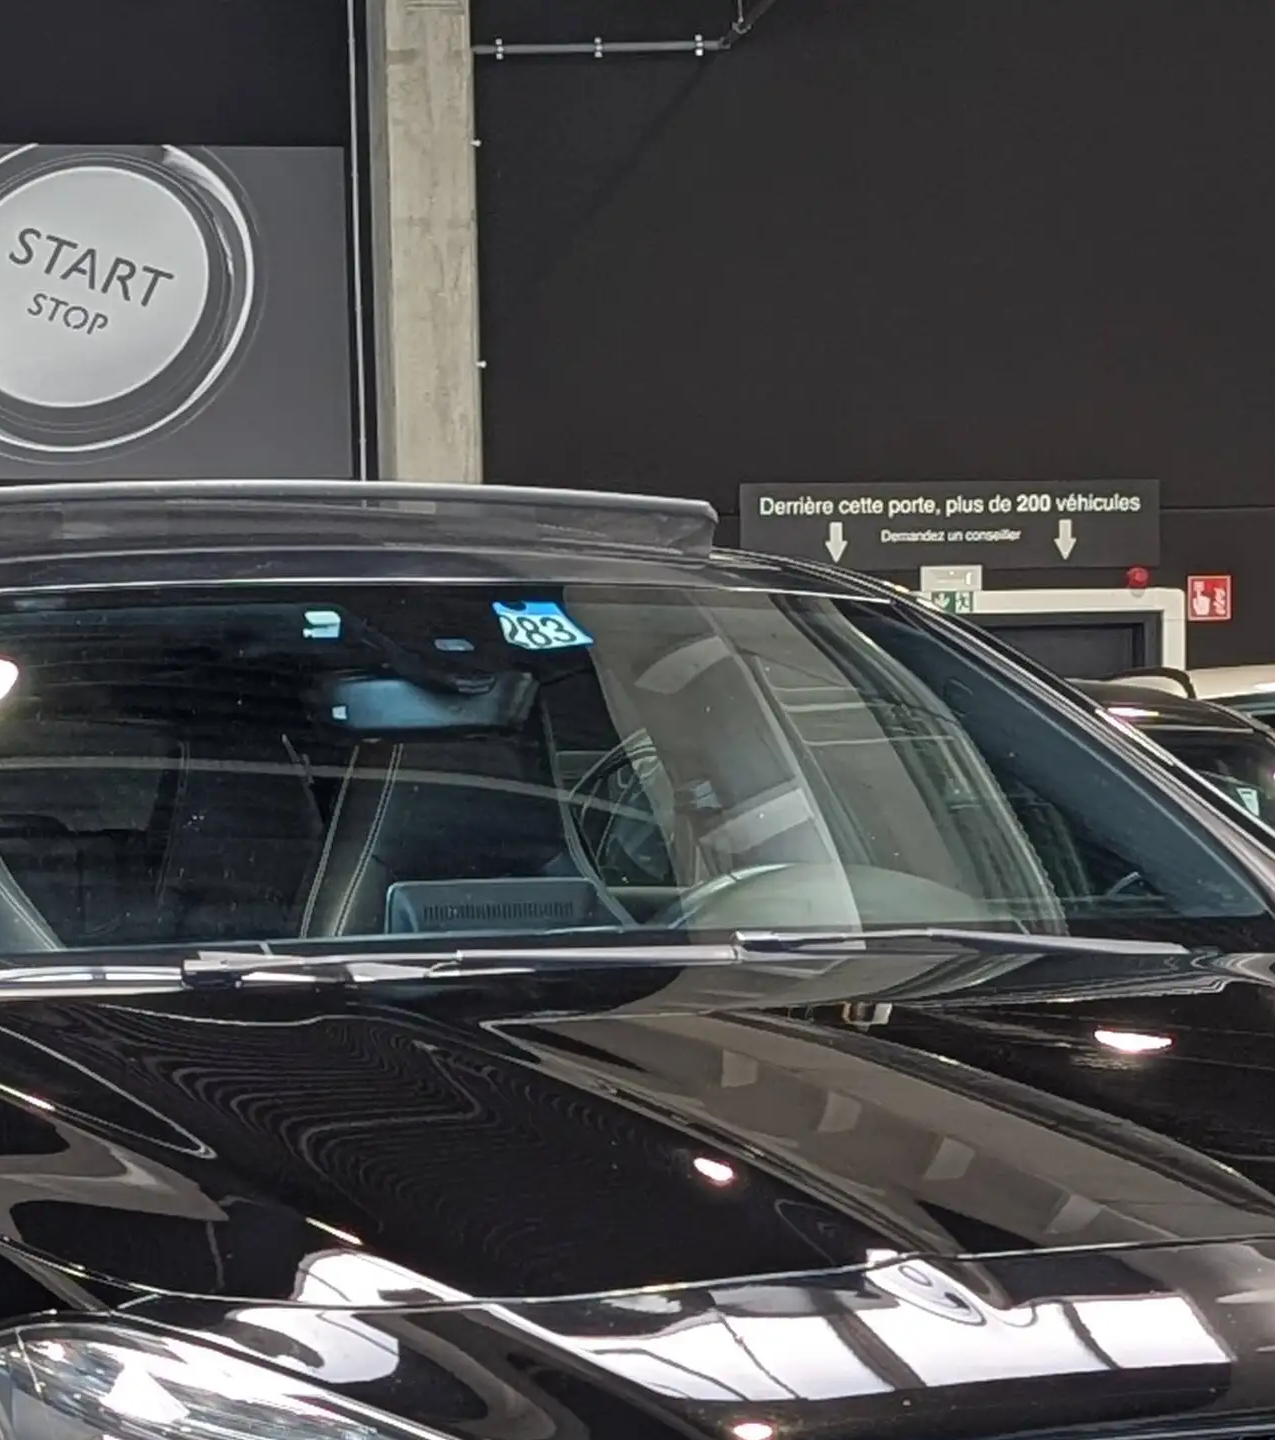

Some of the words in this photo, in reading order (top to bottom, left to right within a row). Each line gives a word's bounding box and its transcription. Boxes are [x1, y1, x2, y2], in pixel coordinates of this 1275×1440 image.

[7, 228, 175, 307] START
[27, 292, 109, 335] STOP
[759, 496, 834, 515] Derrière
[838, 497, 883, 514] cette
[888, 496, 941, 518] porte,
[945, 495, 984, 517] plus
[988, 494, 1012, 513] de
[1016, 494, 1051, 513] 200
[1055, 493, 1141, 513] véhicules
[880, 529, 945, 543] Demandez
[947, 530, 963, 542] un
[964, 528, 1022, 542] conseiller
